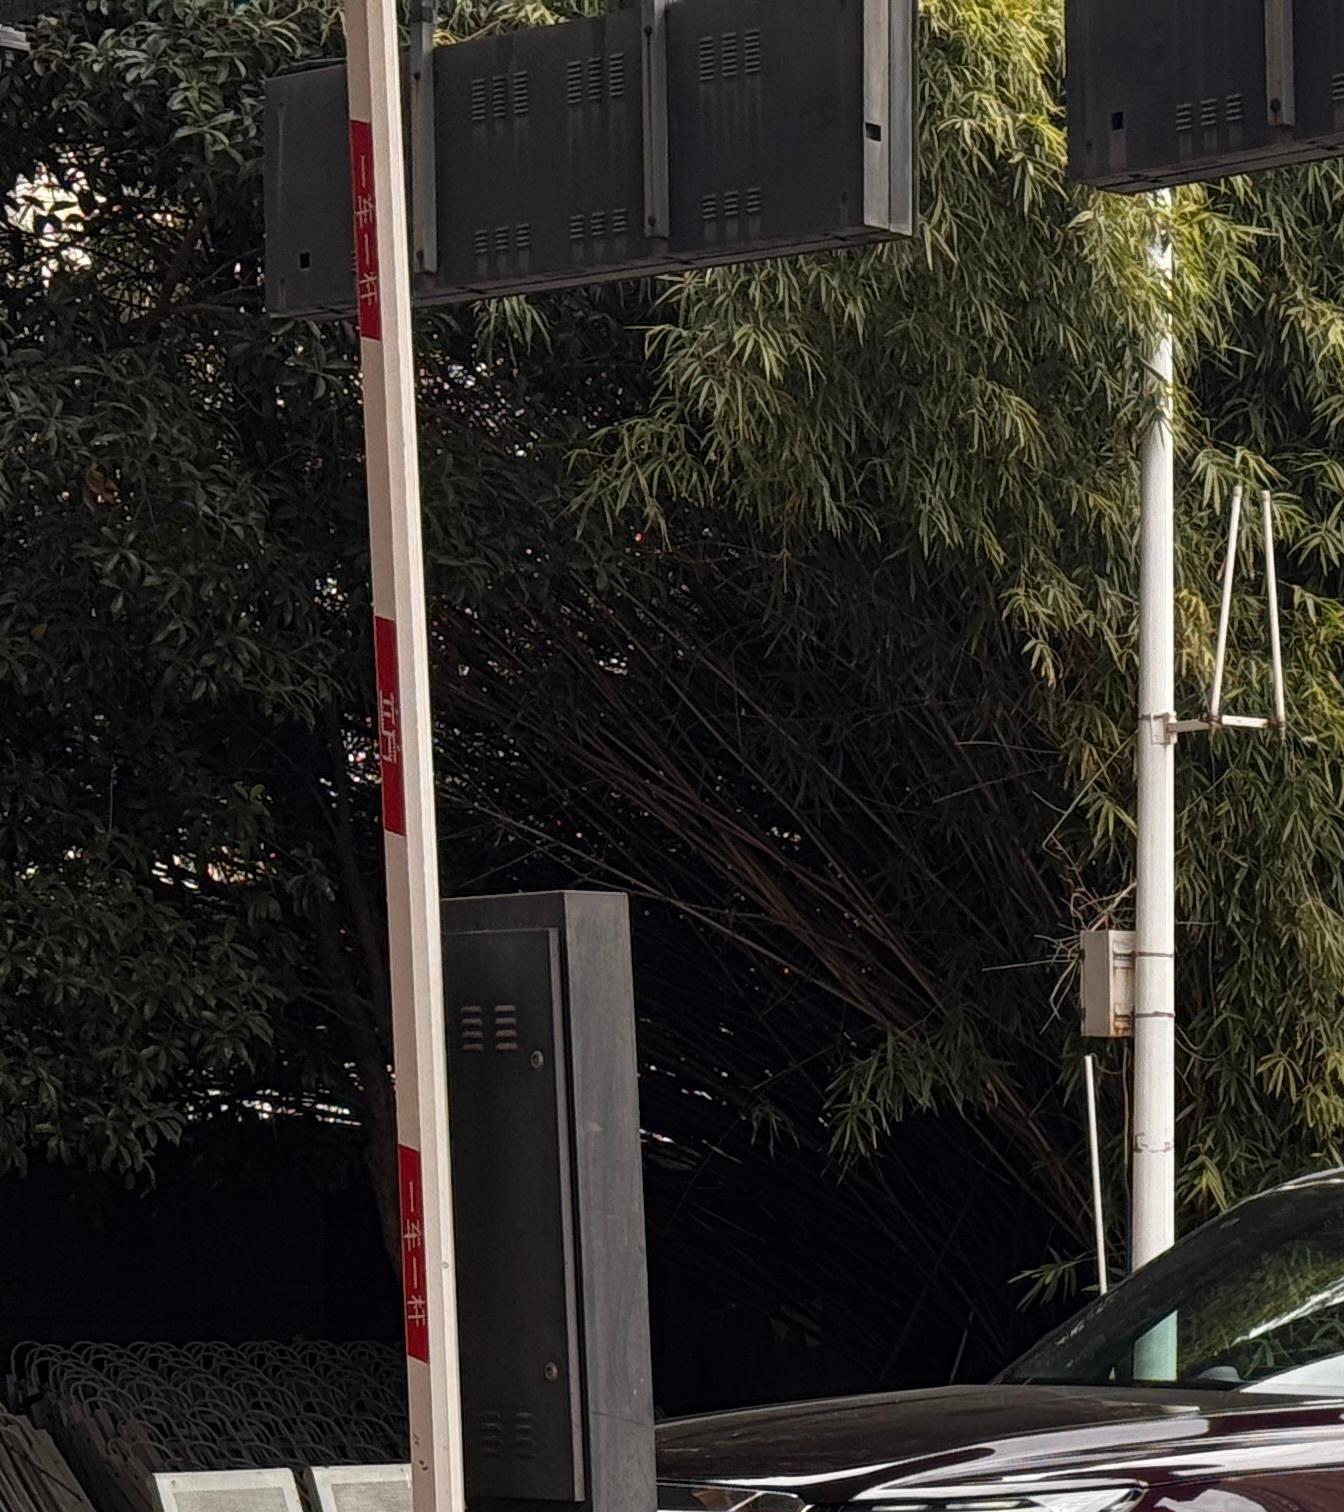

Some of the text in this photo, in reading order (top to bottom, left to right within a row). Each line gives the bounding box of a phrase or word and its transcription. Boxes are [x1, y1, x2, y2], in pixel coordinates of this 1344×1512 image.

[353, 154, 379, 308] 一车一杆
[402, 1180, 427, 1329] 一车一杆
